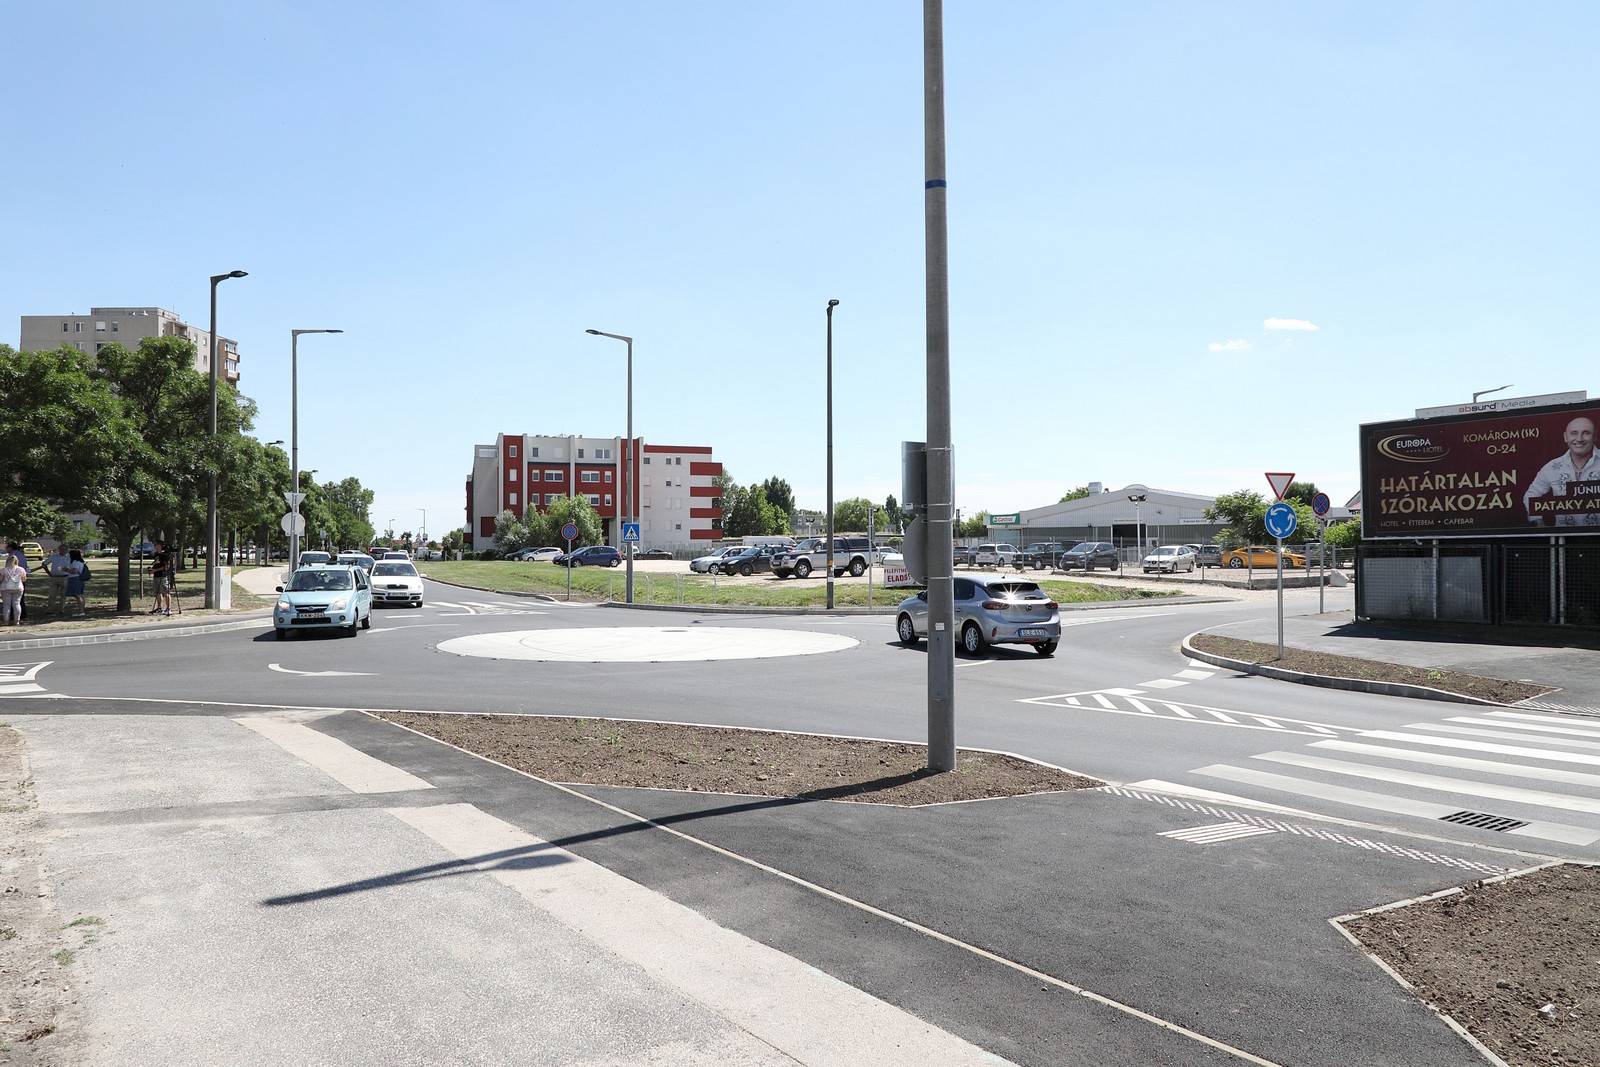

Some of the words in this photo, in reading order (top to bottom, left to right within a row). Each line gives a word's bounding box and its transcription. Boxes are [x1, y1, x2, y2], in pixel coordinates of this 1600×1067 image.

[1458, 403, 1497, 414] absurd
[1396, 438, 1431, 449] EUROPA
[1380, 469, 1517, 493] HATÁRTALAN
[1380, 488, 1513, 514] SZÓRAKOZÁS
[1534, 499, 1583, 511] PATAKY
